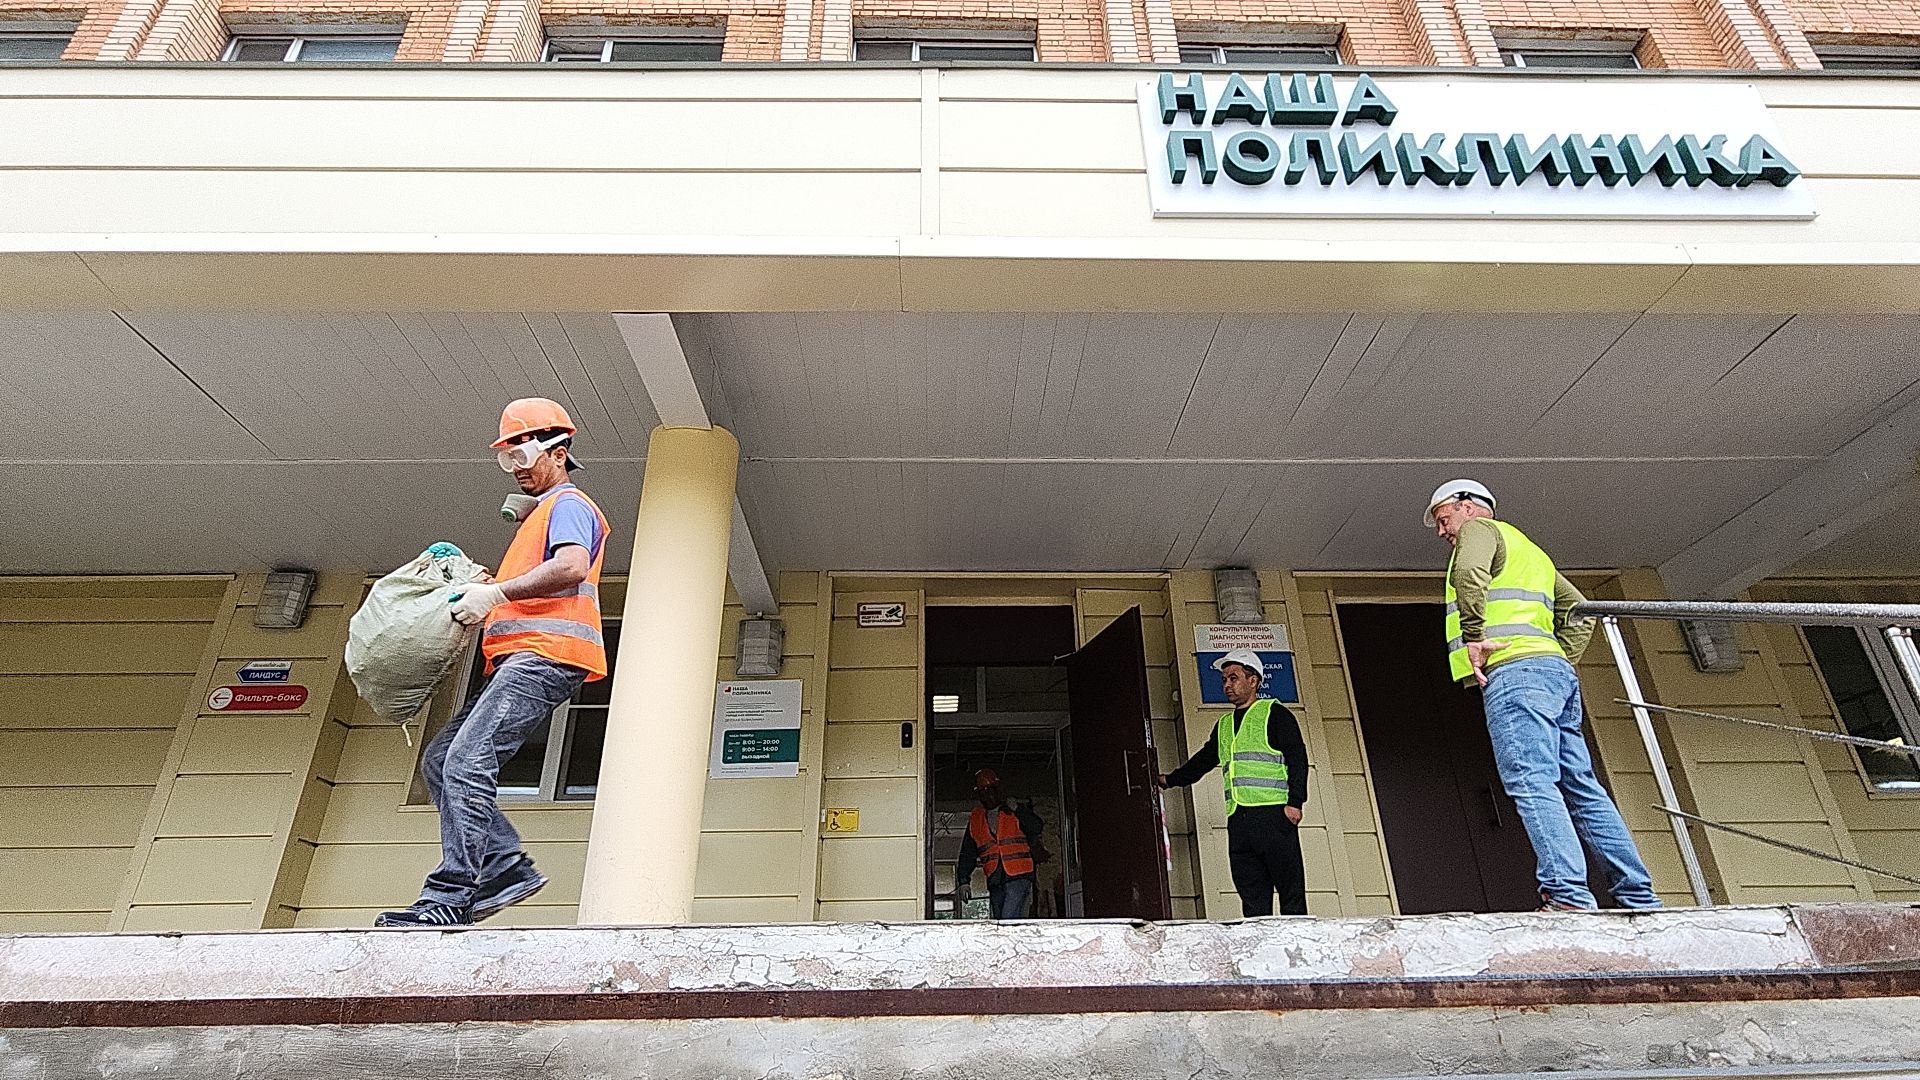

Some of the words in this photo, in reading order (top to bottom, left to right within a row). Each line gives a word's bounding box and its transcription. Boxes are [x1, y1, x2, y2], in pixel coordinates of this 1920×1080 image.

[1157, 73, 1398, 126] НАША
[1166, 130, 1802, 188] ПОЛИКЛИНИКА
[234, 694, 302, 702] Фильтр-бокс
